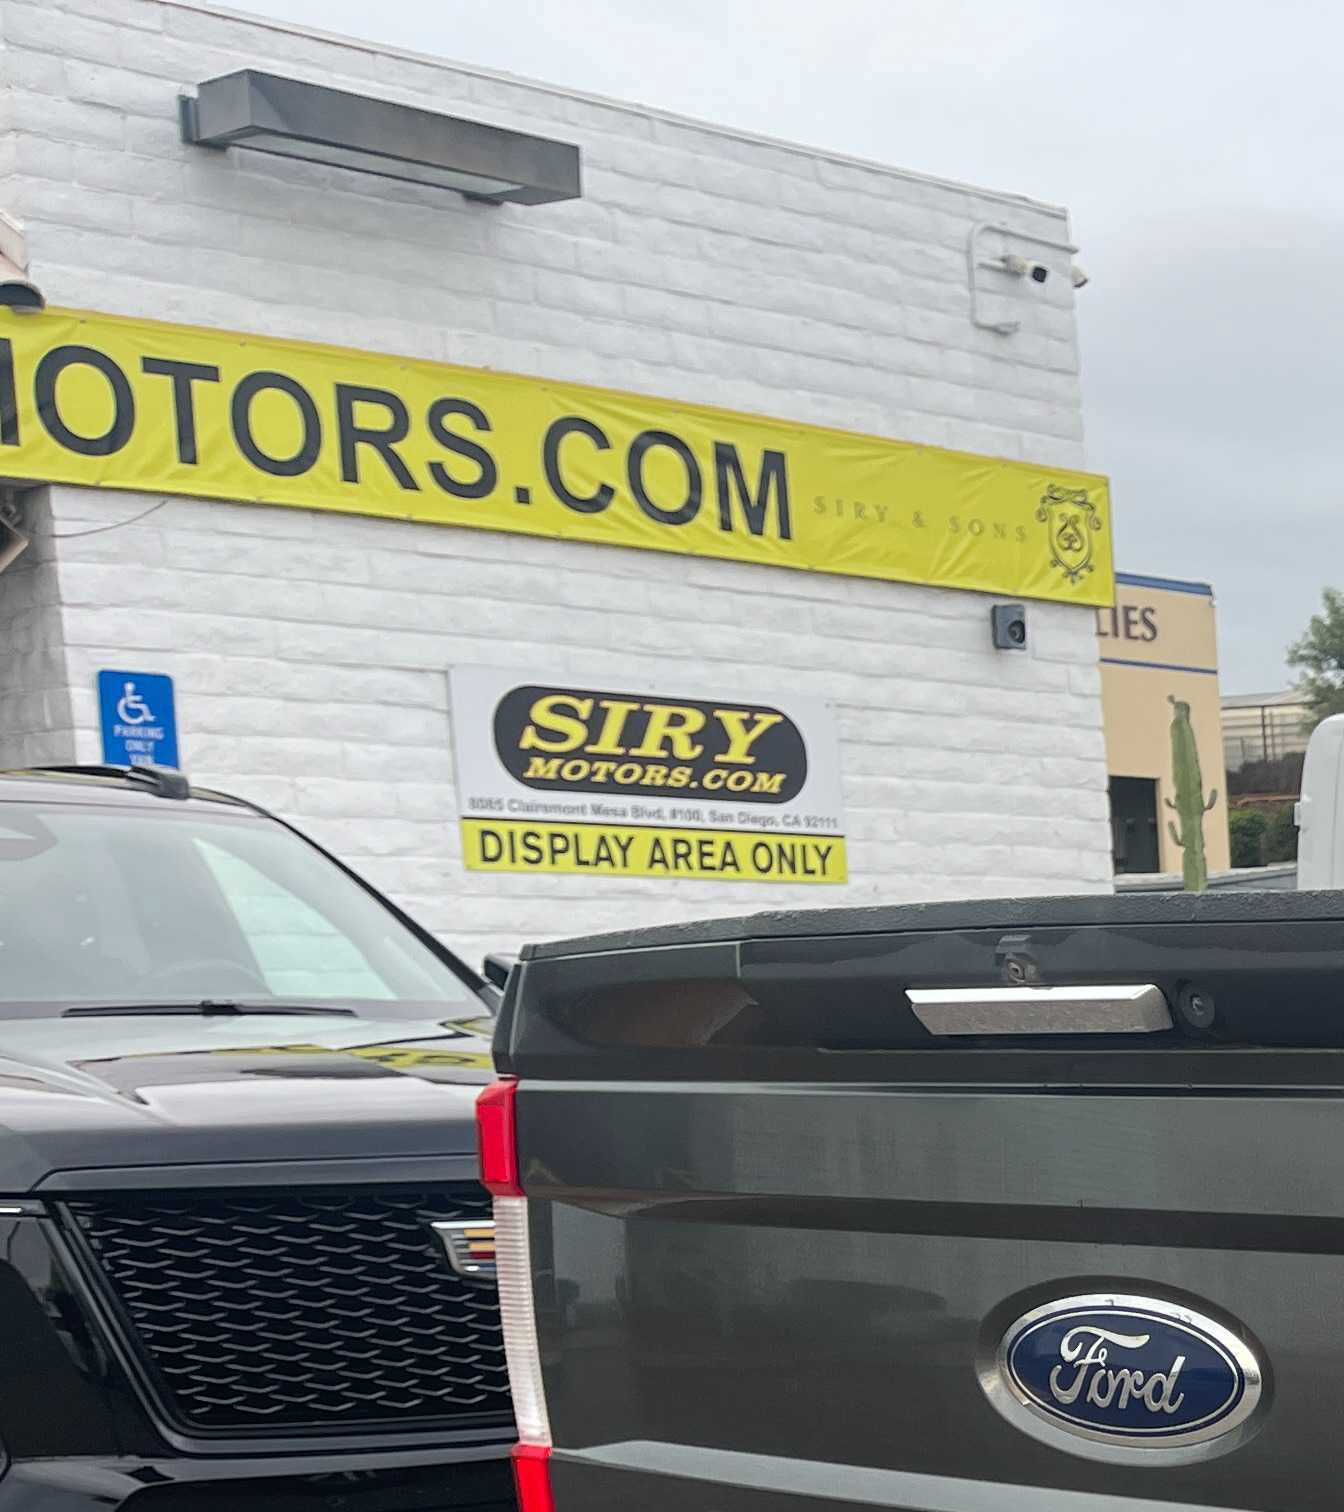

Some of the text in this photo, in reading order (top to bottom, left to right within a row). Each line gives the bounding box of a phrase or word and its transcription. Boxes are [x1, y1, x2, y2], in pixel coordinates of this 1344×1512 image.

[814, 496, 1027, 542] SIRY & SONS
[519, 695, 783, 764] SIRY
[523, 756, 786, 793] MOTORS.COM
[480, 829, 832, 876] DISPLAY AREA ONLY
[1049, 1326, 1186, 1414] Ford
